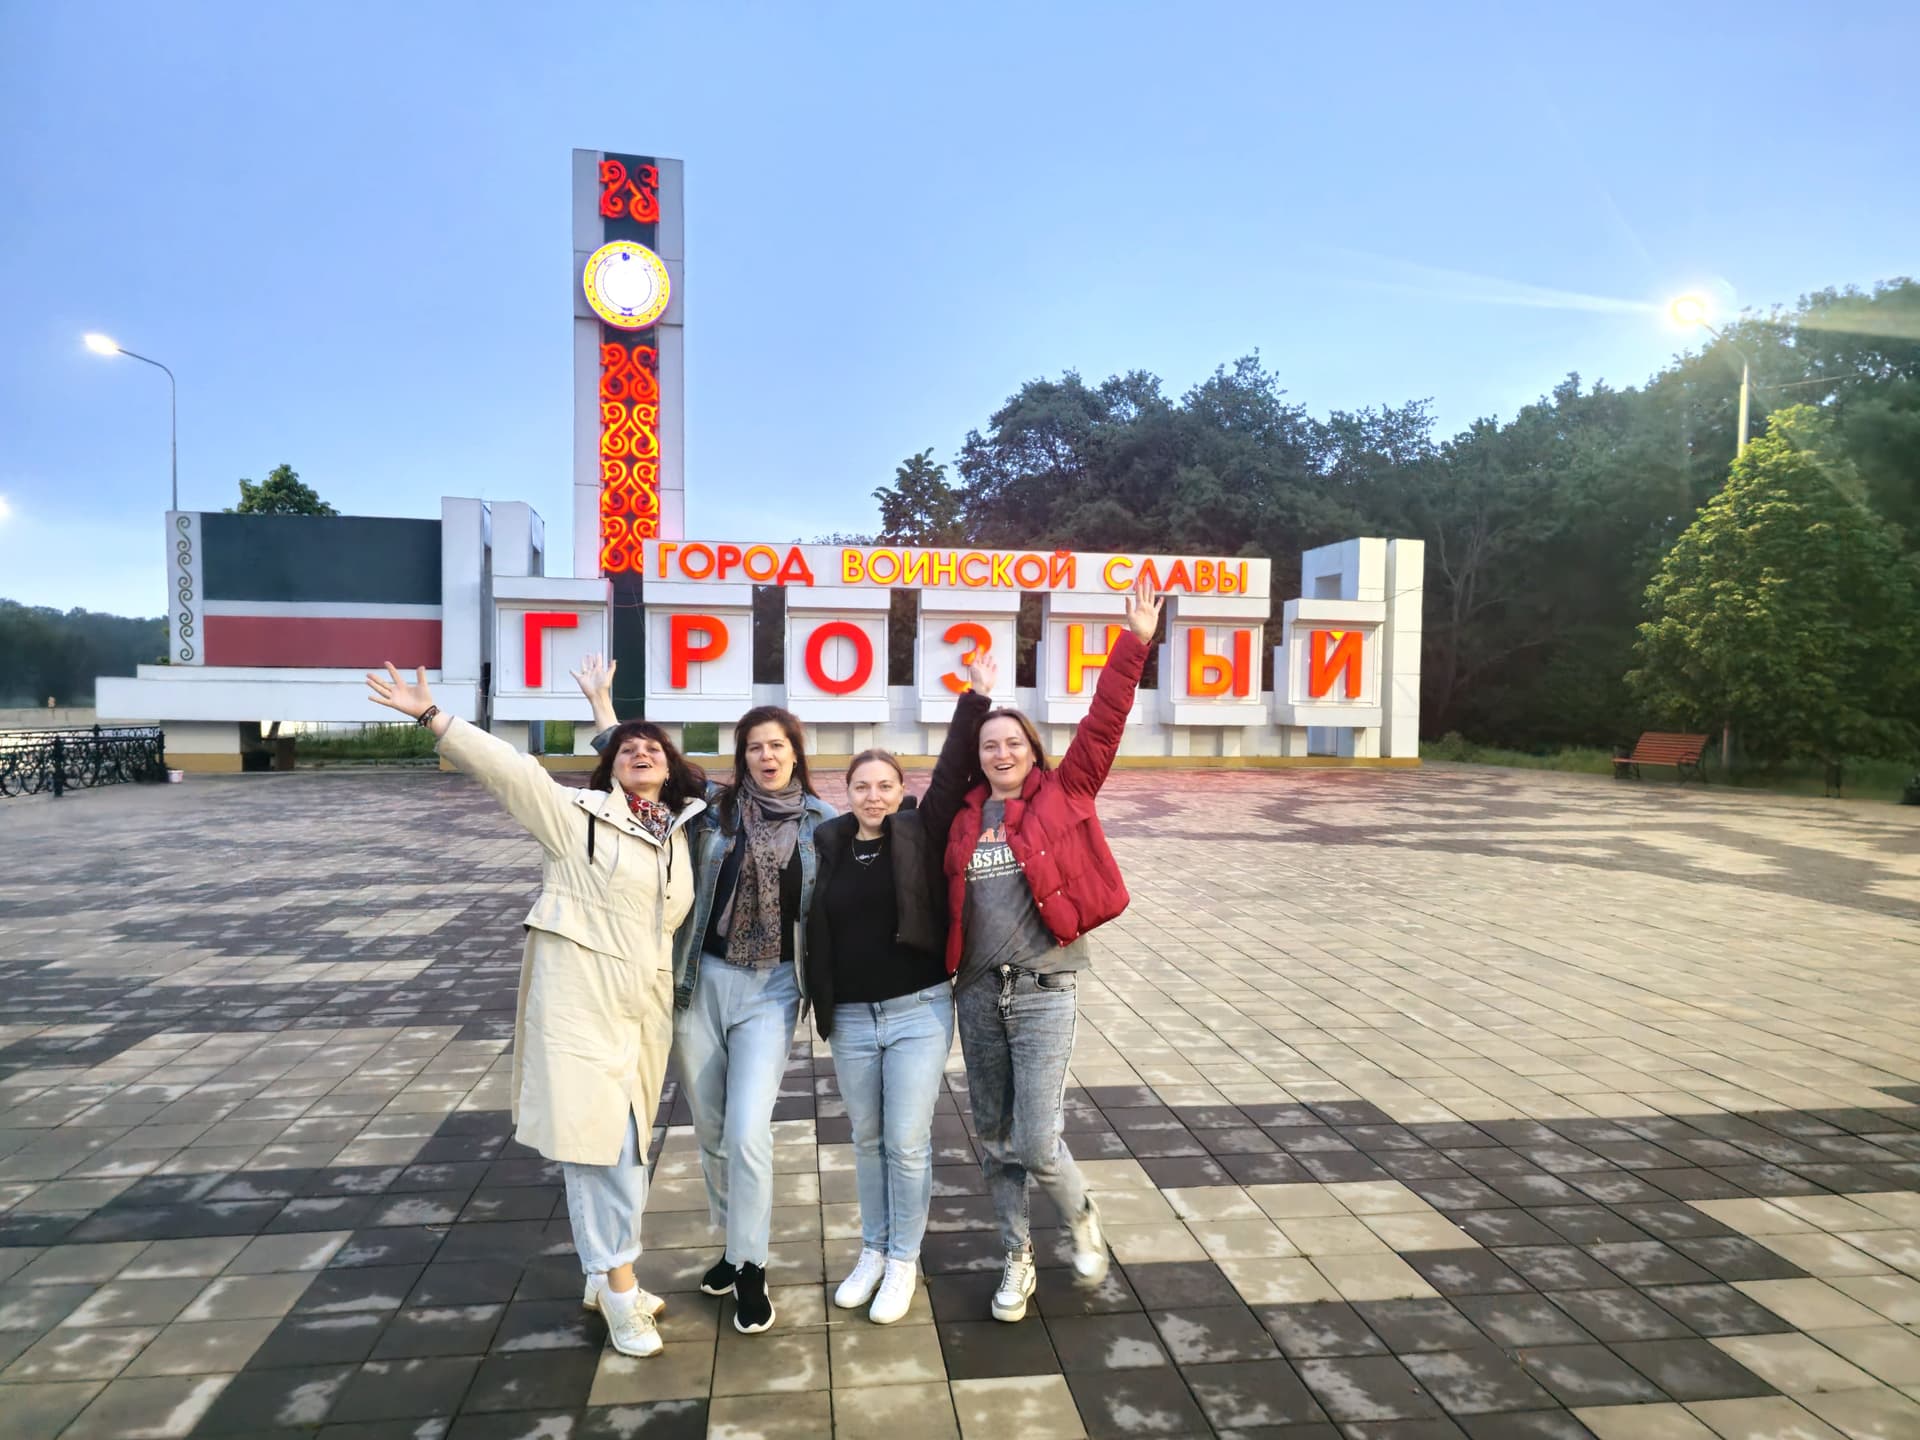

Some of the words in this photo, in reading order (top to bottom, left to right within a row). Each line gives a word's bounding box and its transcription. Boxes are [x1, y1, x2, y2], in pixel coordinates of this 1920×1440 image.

[658, 543, 814, 587] ГОРОД
[841, 548, 1076, 589] ВОИНСКОЙ
[1103, 556, 1248, 594] СЛАВЫ
[523, 611, 1364, 699] ГРОЗНЫЙ
[967, 846, 1017, 870] BSAR
